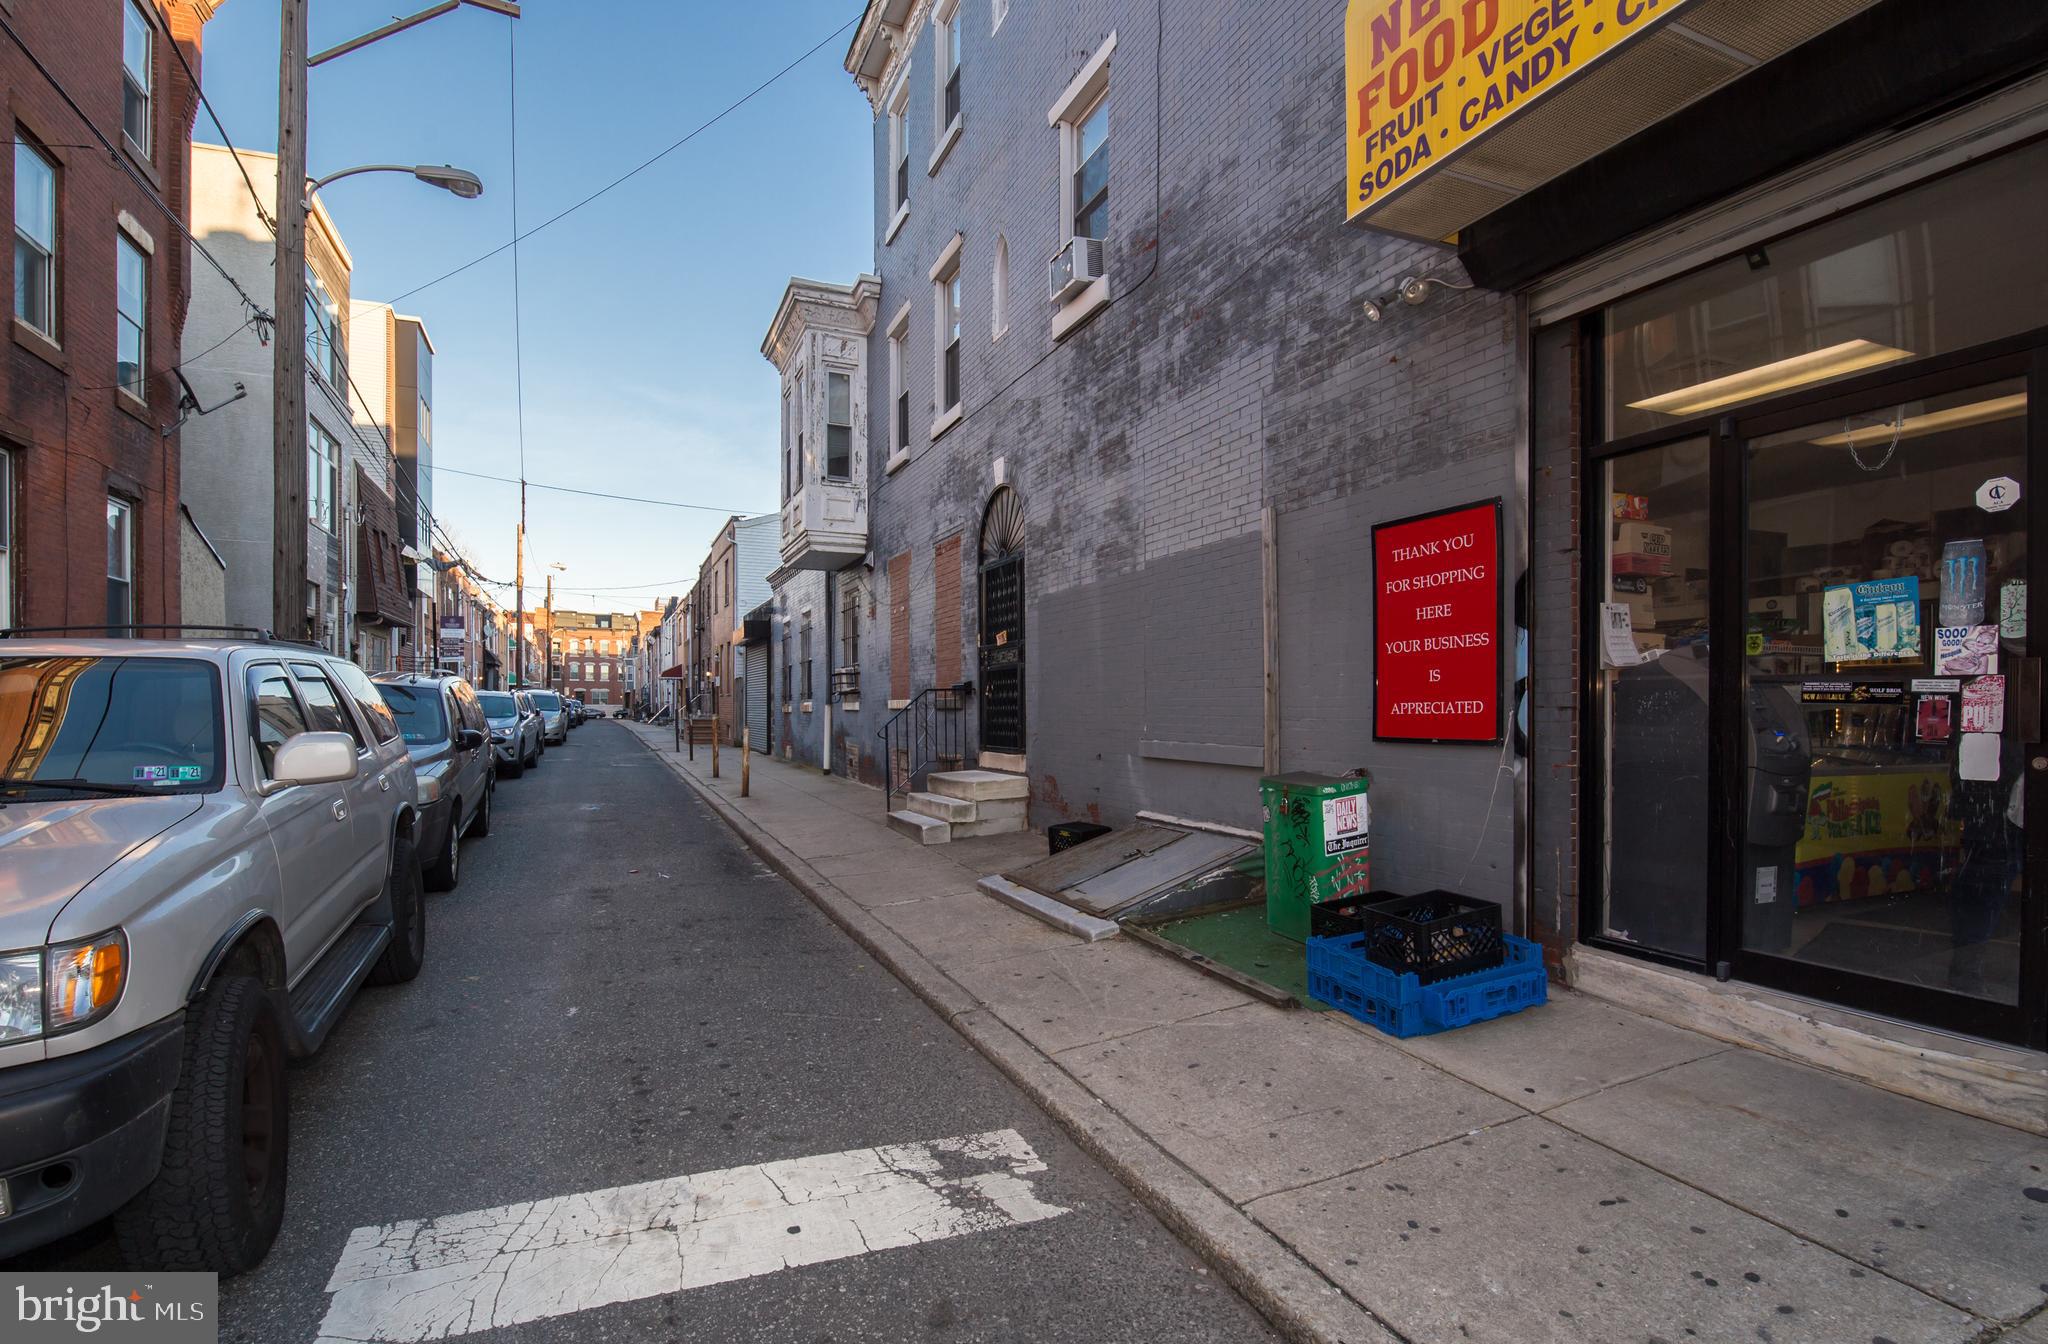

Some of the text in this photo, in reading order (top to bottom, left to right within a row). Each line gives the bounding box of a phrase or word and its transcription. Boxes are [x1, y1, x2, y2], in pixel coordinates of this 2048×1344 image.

[1358, 0, 1499, 138] FOOD
[1366, 0, 1593, 164] FRUIT VEGE
[1359, 132, 1432, 202] SODA
[1459, 24, 1580, 132] CANDY
[1392, 533, 1475, 562] THANK YOU
[1386, 565, 1485, 594] FOR SHOPPING
[1416, 603, 1452, 620] HERE
[1937, 628, 1968, 639] SOOO
[1386, 632, 1490, 654] YOUR BUSINESS
[1429, 669, 1441, 682] IS
[1391, 700, 1484, 715] APPRECIATED
[156, 767, 165, 776] 21
[190, 767, 200, 777] 21
[1336, 800, 1356, 817] DAILY
[1337, 814, 1357, 831] NEWS
[1327, 836, 1368, 851] The Inquirer
